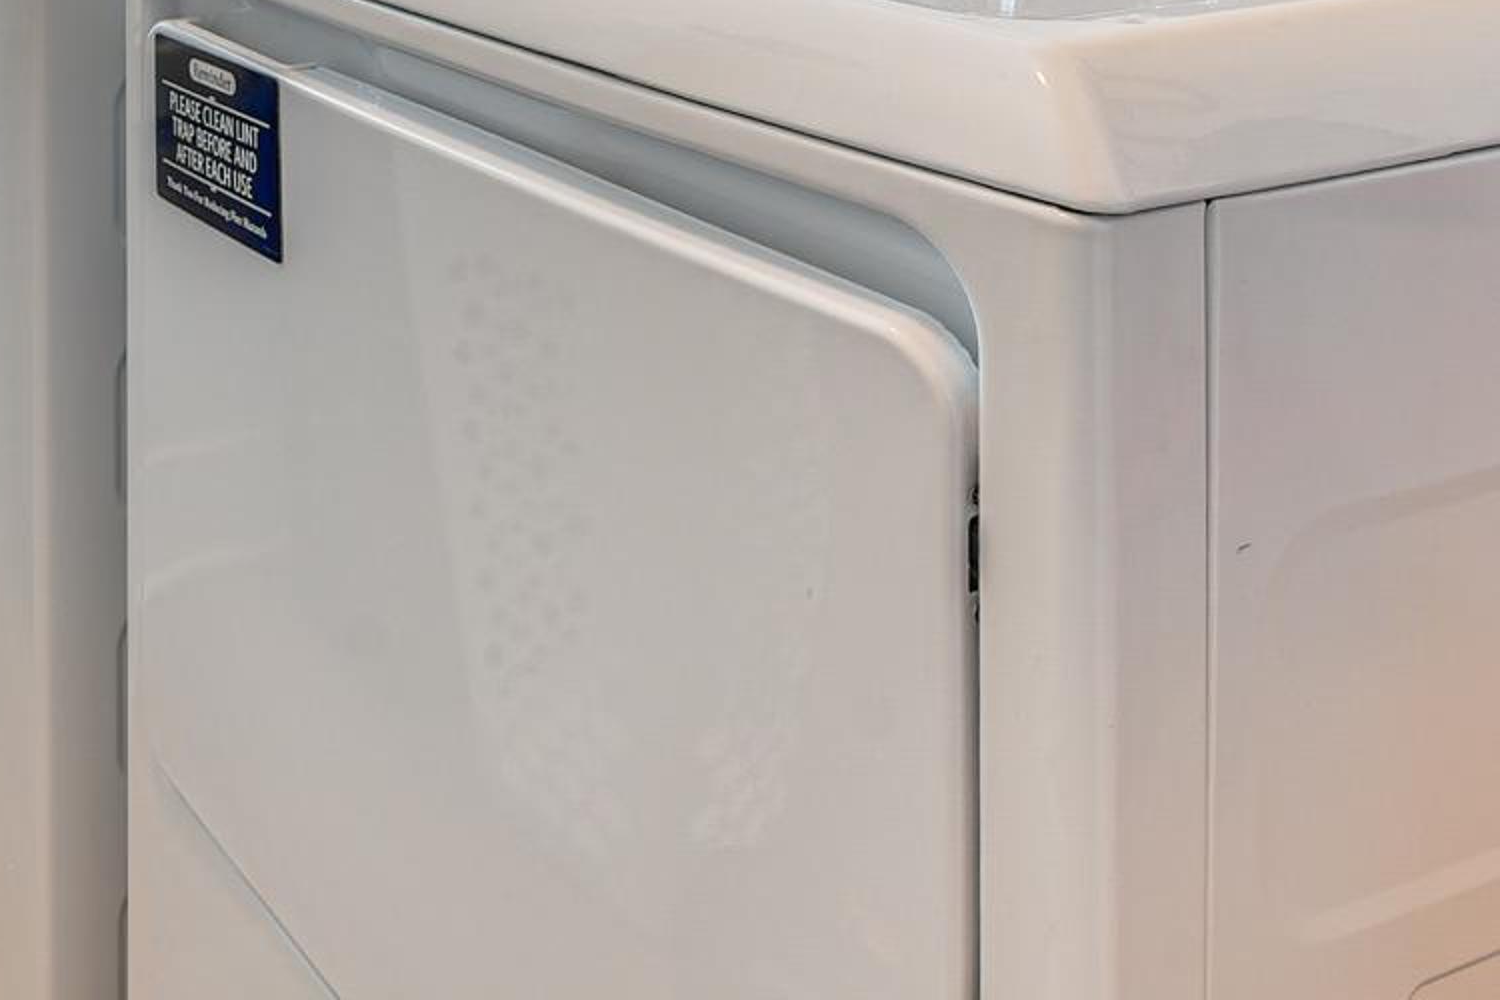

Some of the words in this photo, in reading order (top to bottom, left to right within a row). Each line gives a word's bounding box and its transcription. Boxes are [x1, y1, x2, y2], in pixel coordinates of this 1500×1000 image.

[169, 91, 202, 124] PLEASE
[202, 104, 235, 138] CLEAN
[235, 119, 260, 150] LINT
[172, 115, 195, 142] TRAP
[195, 127, 233, 163] BEFORE
[233, 147, 258, 175] AND
[175, 143, 205, 175] AFTER
[205, 156, 232, 190] EACH
[233, 170, 253, 199] USE
